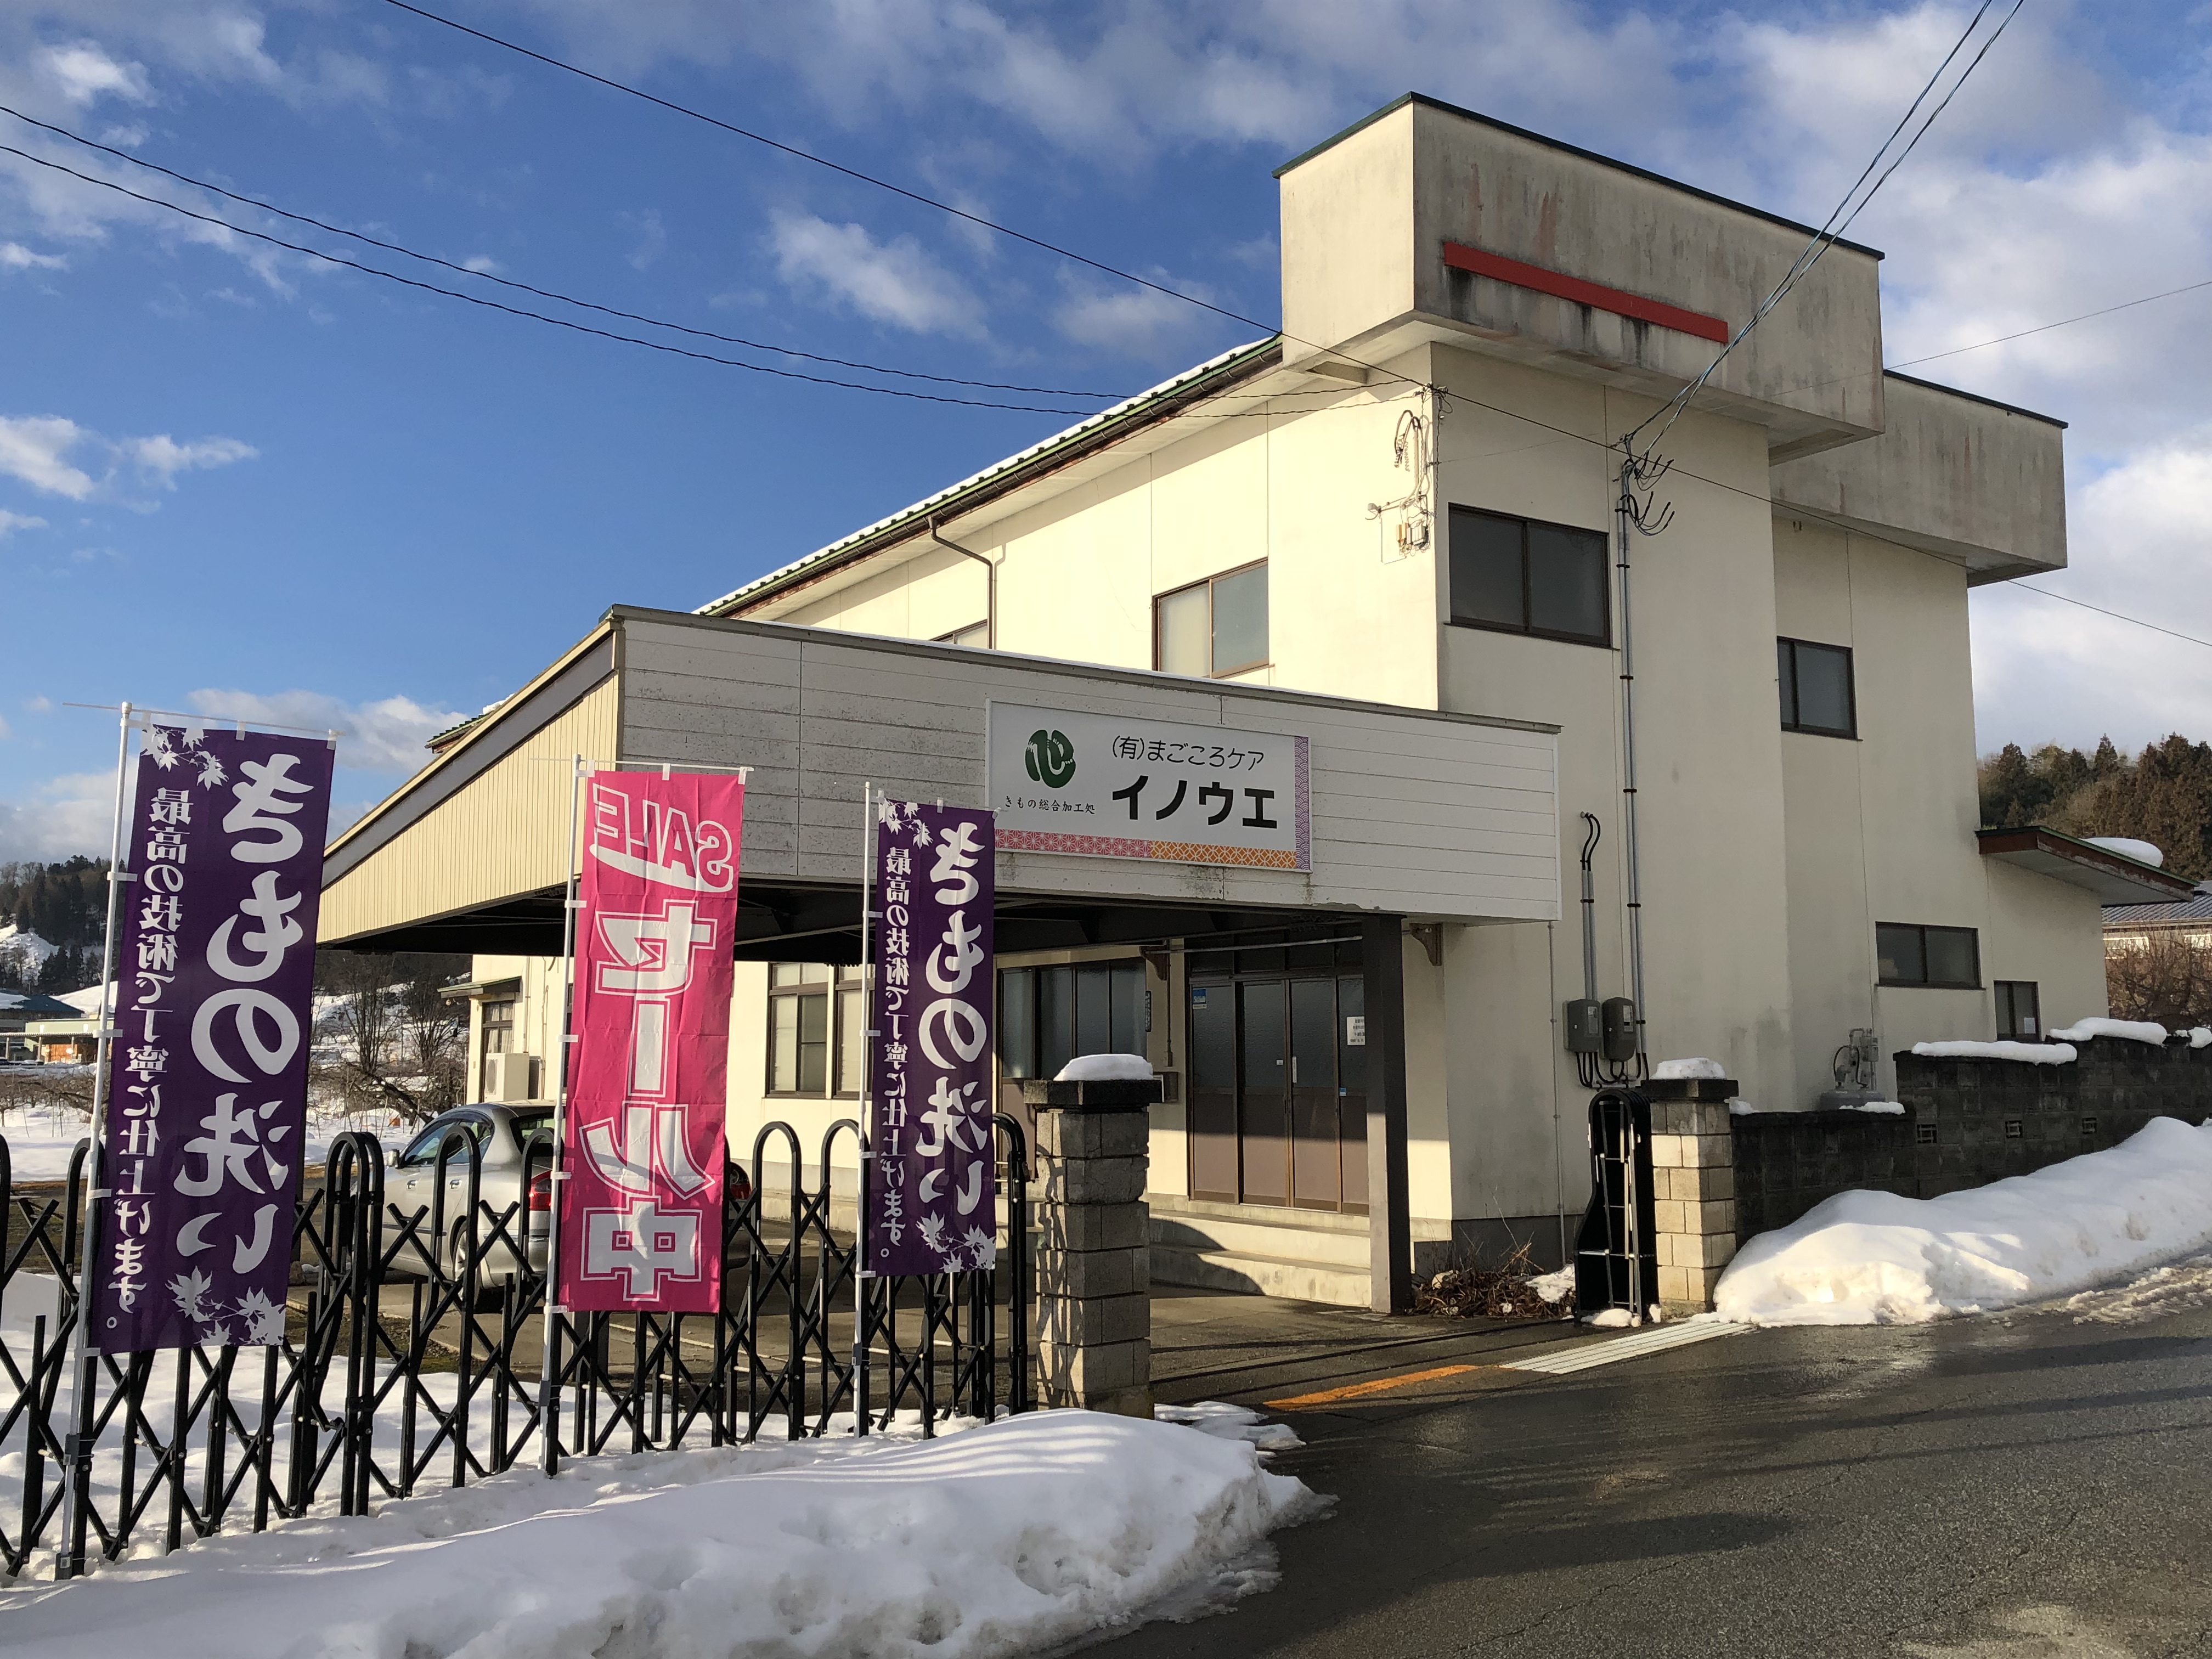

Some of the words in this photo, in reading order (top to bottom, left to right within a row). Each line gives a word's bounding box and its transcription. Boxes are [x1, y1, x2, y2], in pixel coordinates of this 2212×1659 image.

[1112, 735, 1264, 771] (有)まごころケア
[1005, 795, 1096, 815] きもの総合加工処
[1112, 775, 1278, 829] イノウエ
